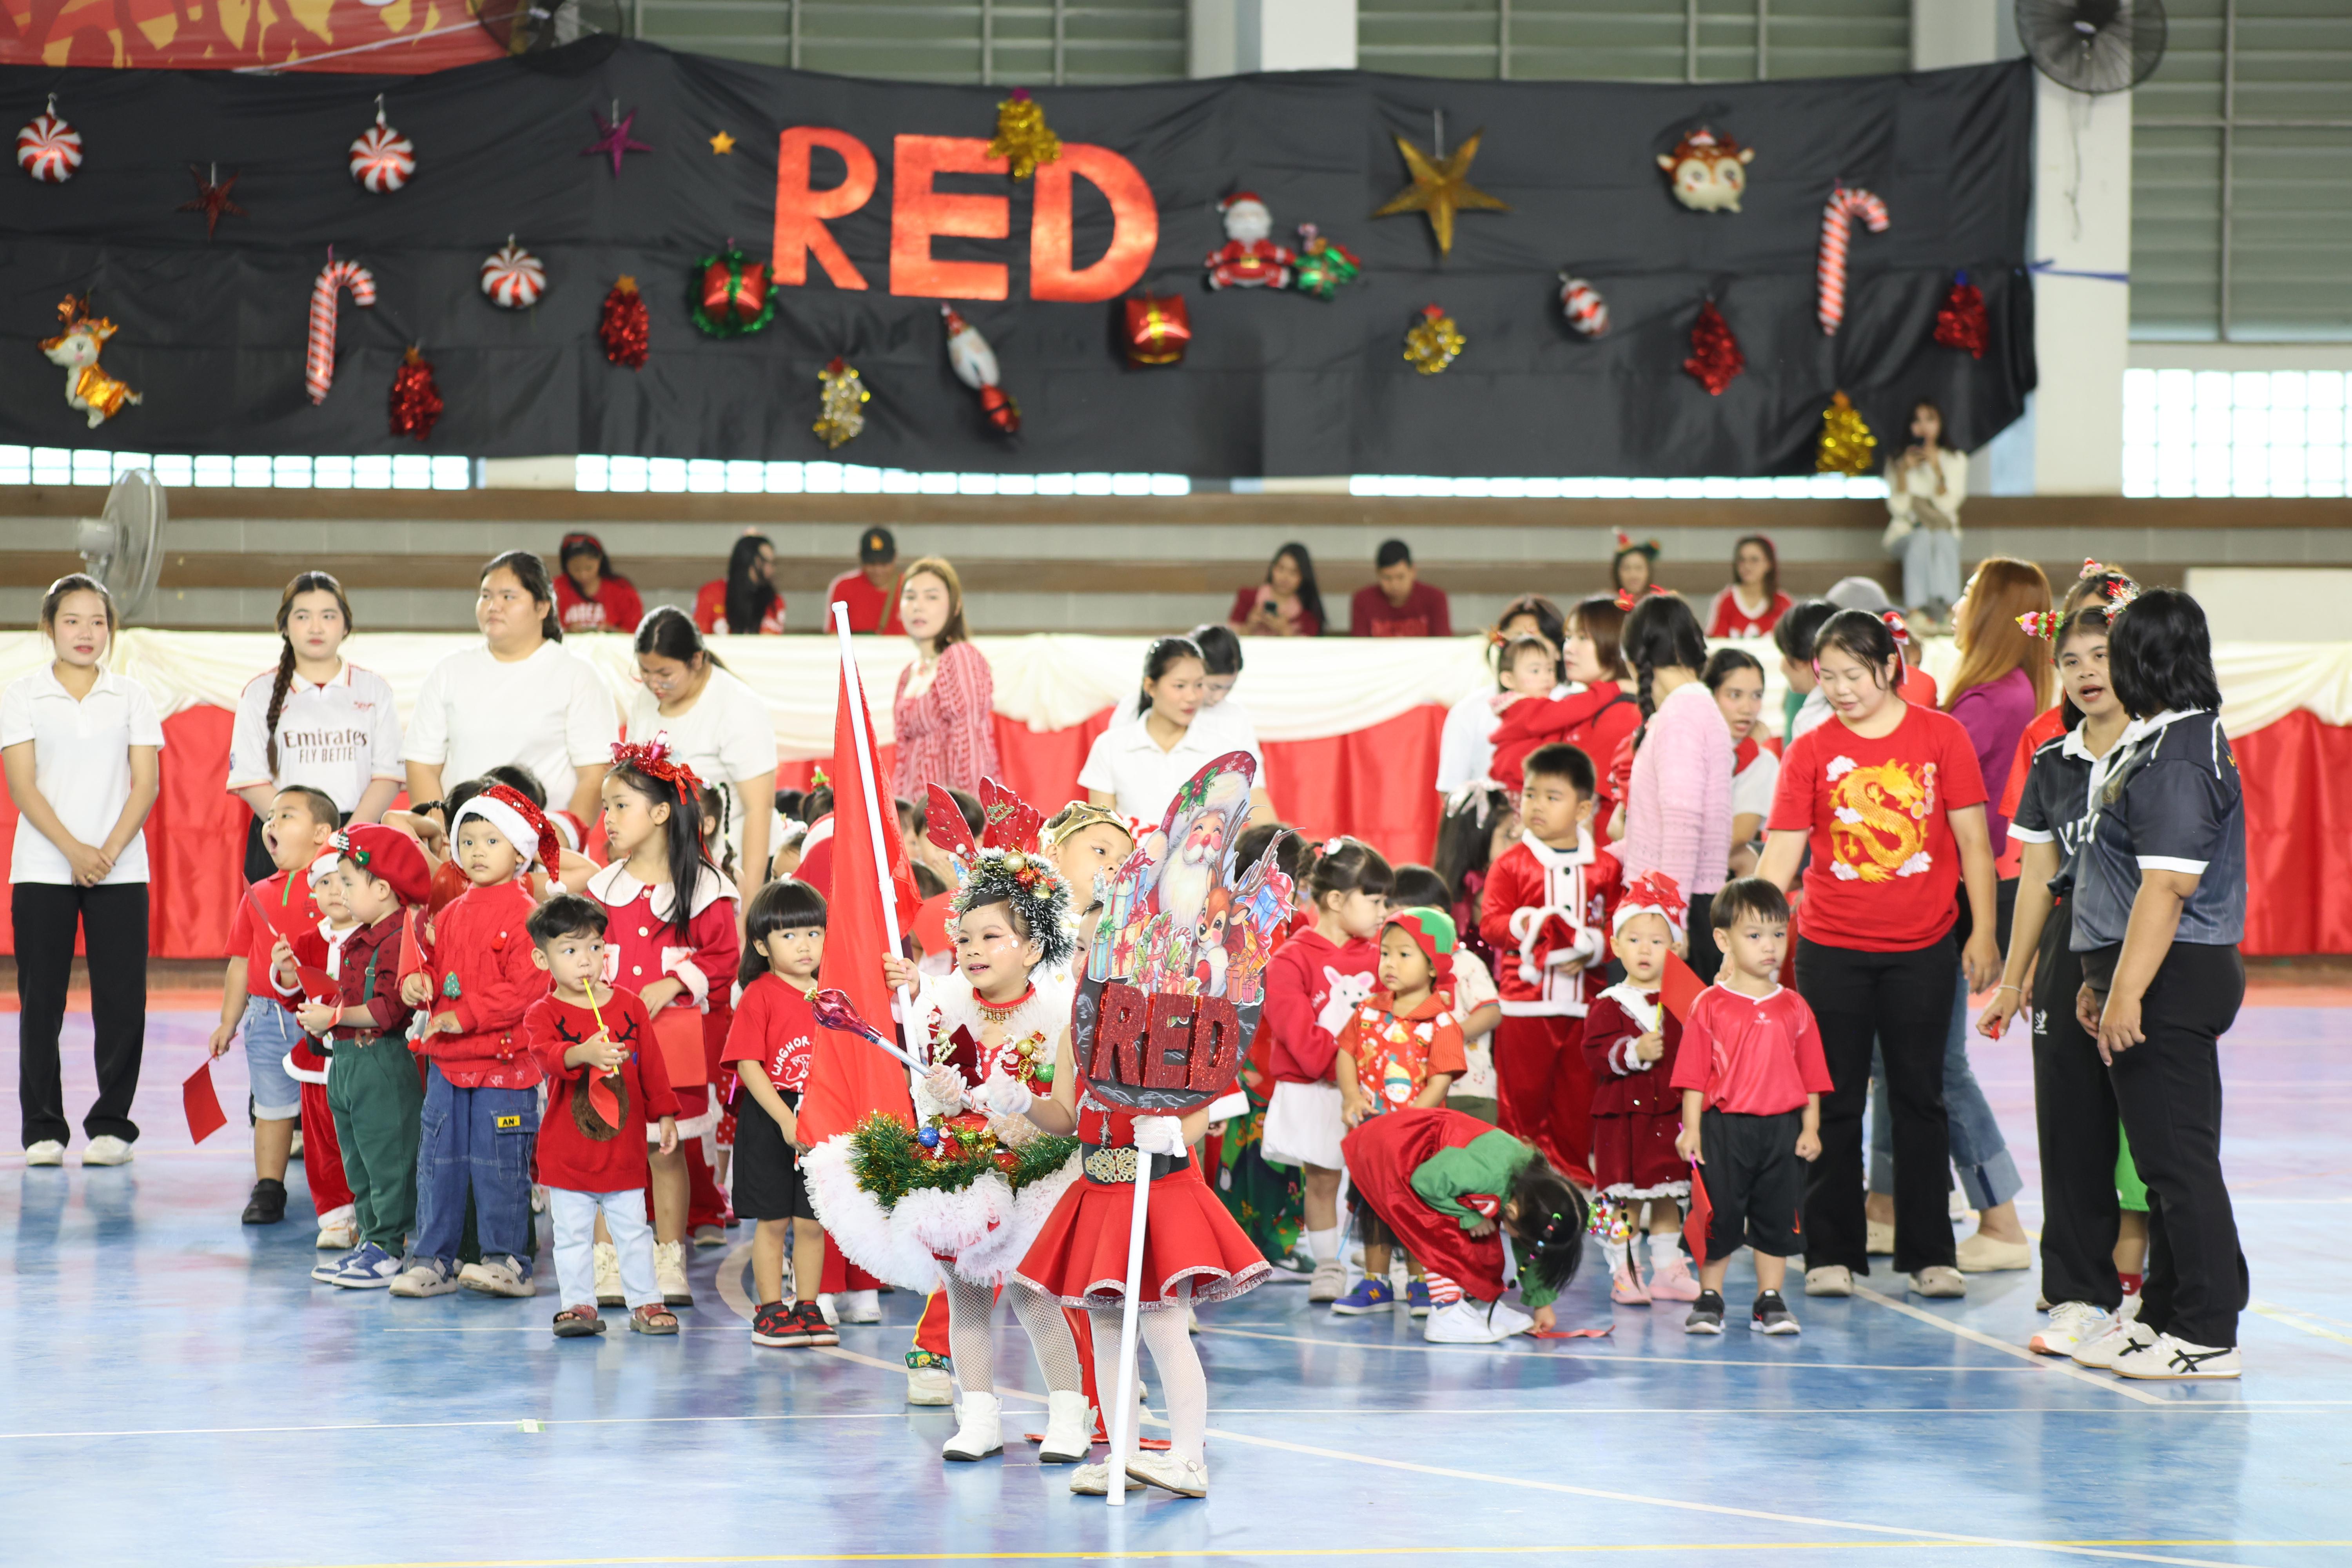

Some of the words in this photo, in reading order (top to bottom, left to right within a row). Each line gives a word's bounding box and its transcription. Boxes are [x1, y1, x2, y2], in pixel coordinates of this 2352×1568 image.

[772, 126, 1158, 302] RED
[283, 728, 367, 748] Emirates
[299, 748, 317, 763] FLY
[771, 1035, 813, 1076] WAGHOR
[1089, 982, 1240, 1091] RED
